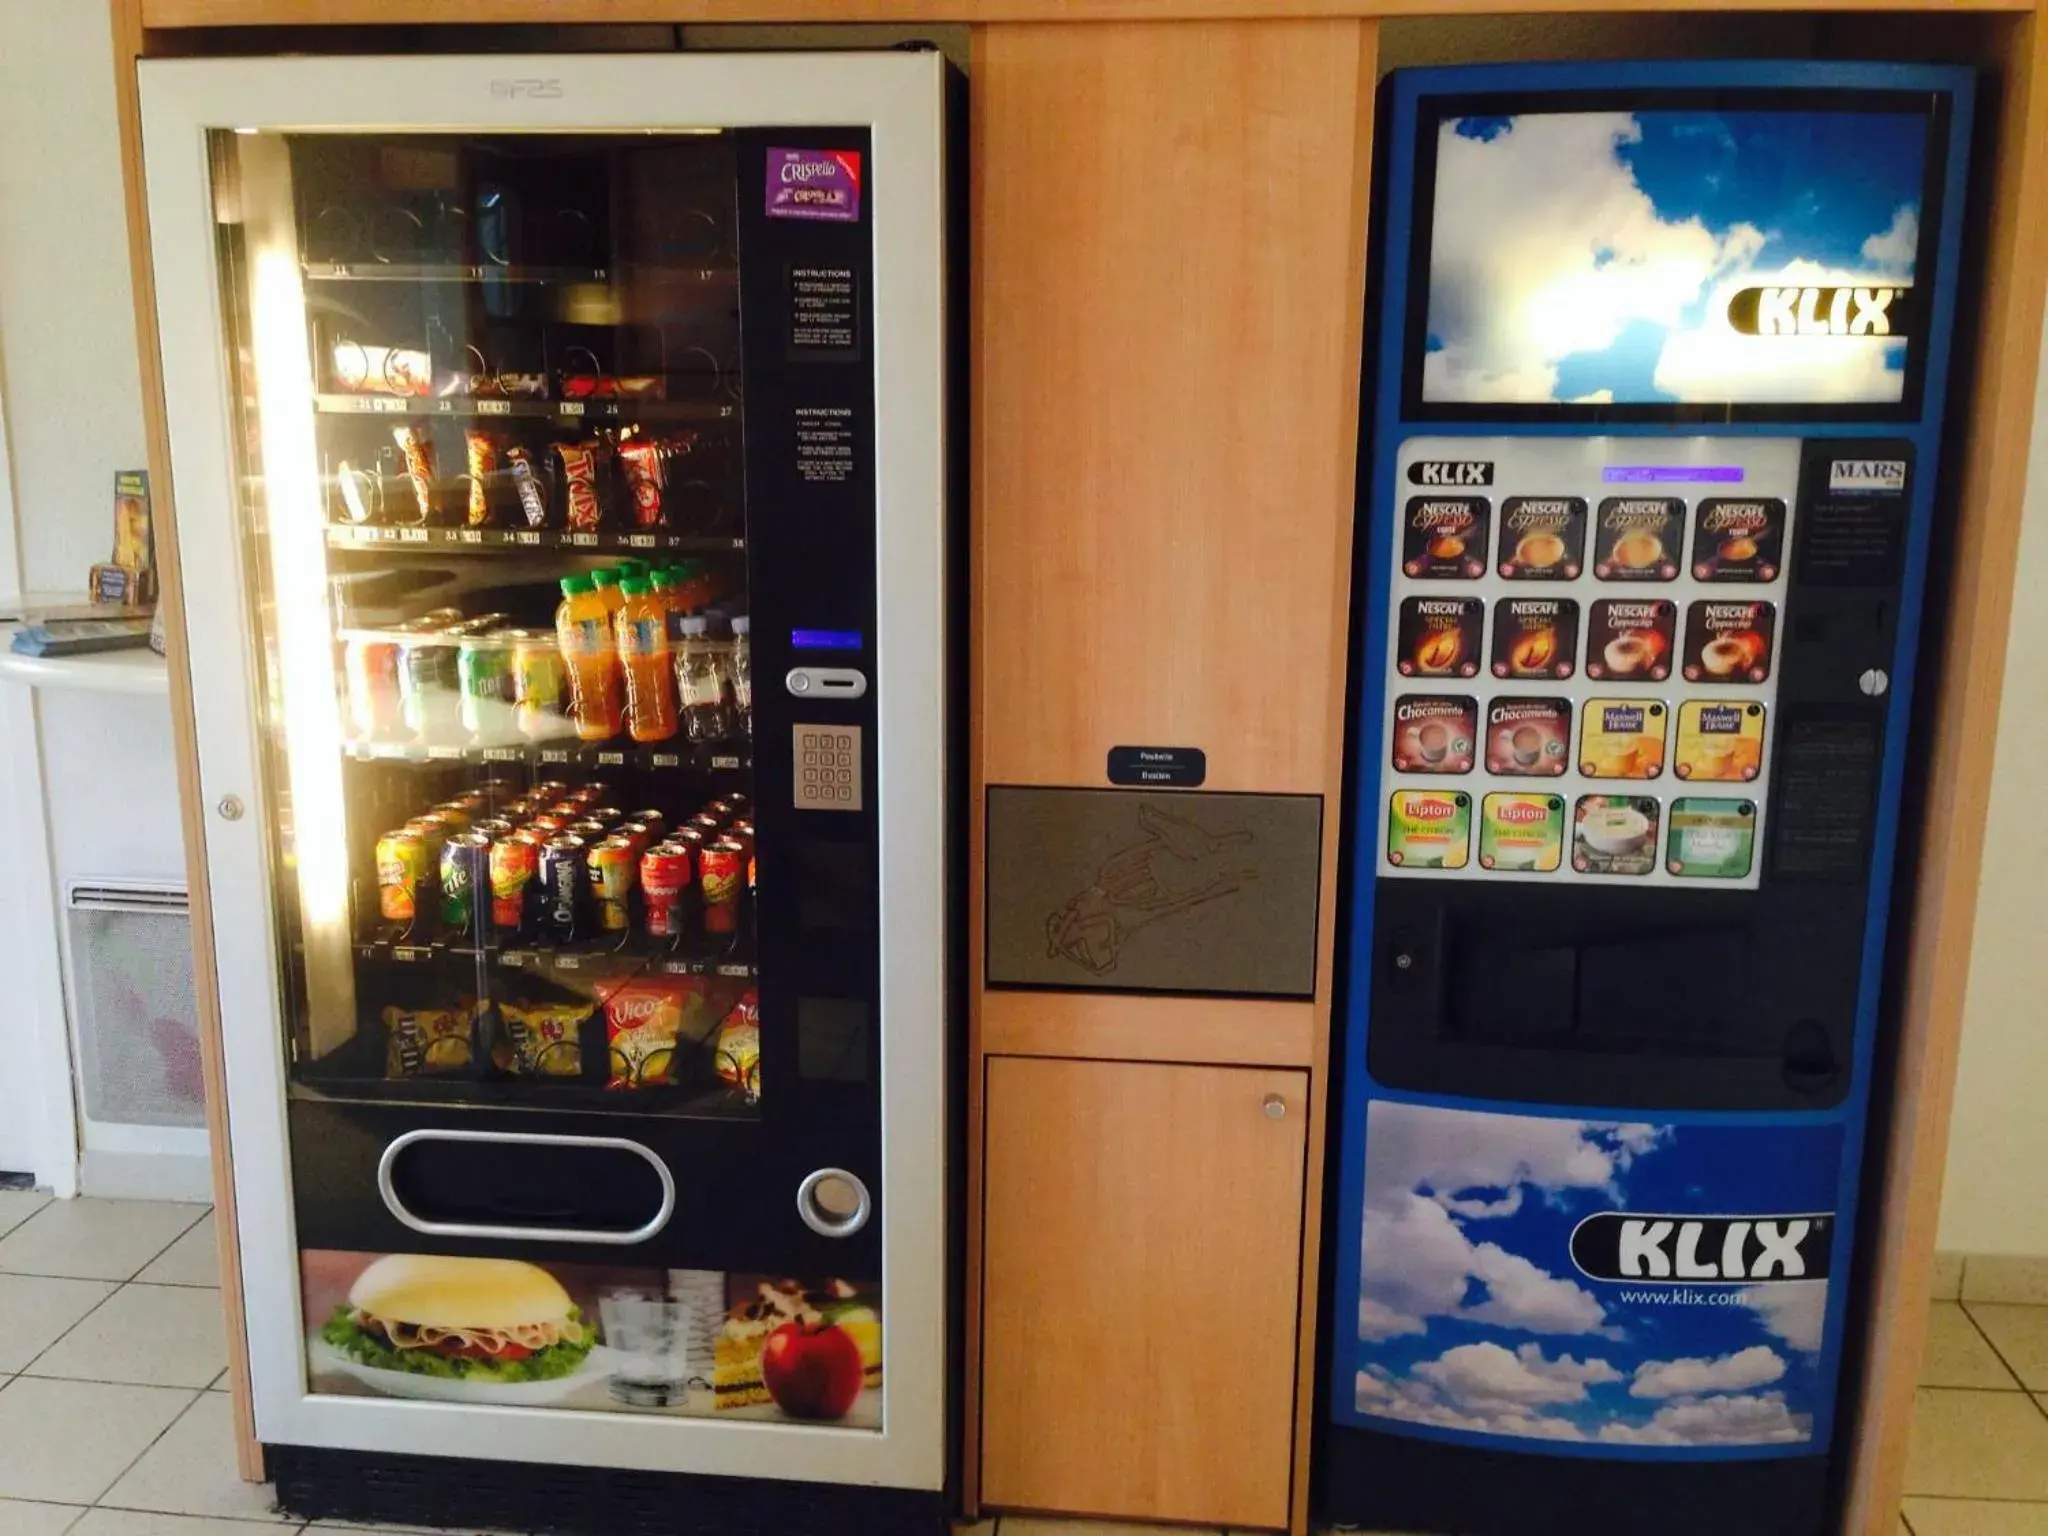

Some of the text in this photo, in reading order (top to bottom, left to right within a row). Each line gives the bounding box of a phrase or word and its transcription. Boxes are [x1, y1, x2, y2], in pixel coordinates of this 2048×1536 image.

[793, 269, 851, 278] INSTRUCTIONS
[1758, 288, 1893, 335] KLIX
[1422, 463, 1486, 485] KLIX
[1834, 463, 1903, 478] MARS
[1408, 804, 1452, 818] Lipton
[1500, 807, 1544, 820] Lipton
[615, 1000, 655, 1025] Vico
[1619, 1220, 1810, 1278] KLIX
[1620, 1289, 1747, 1306] www.klix.com
